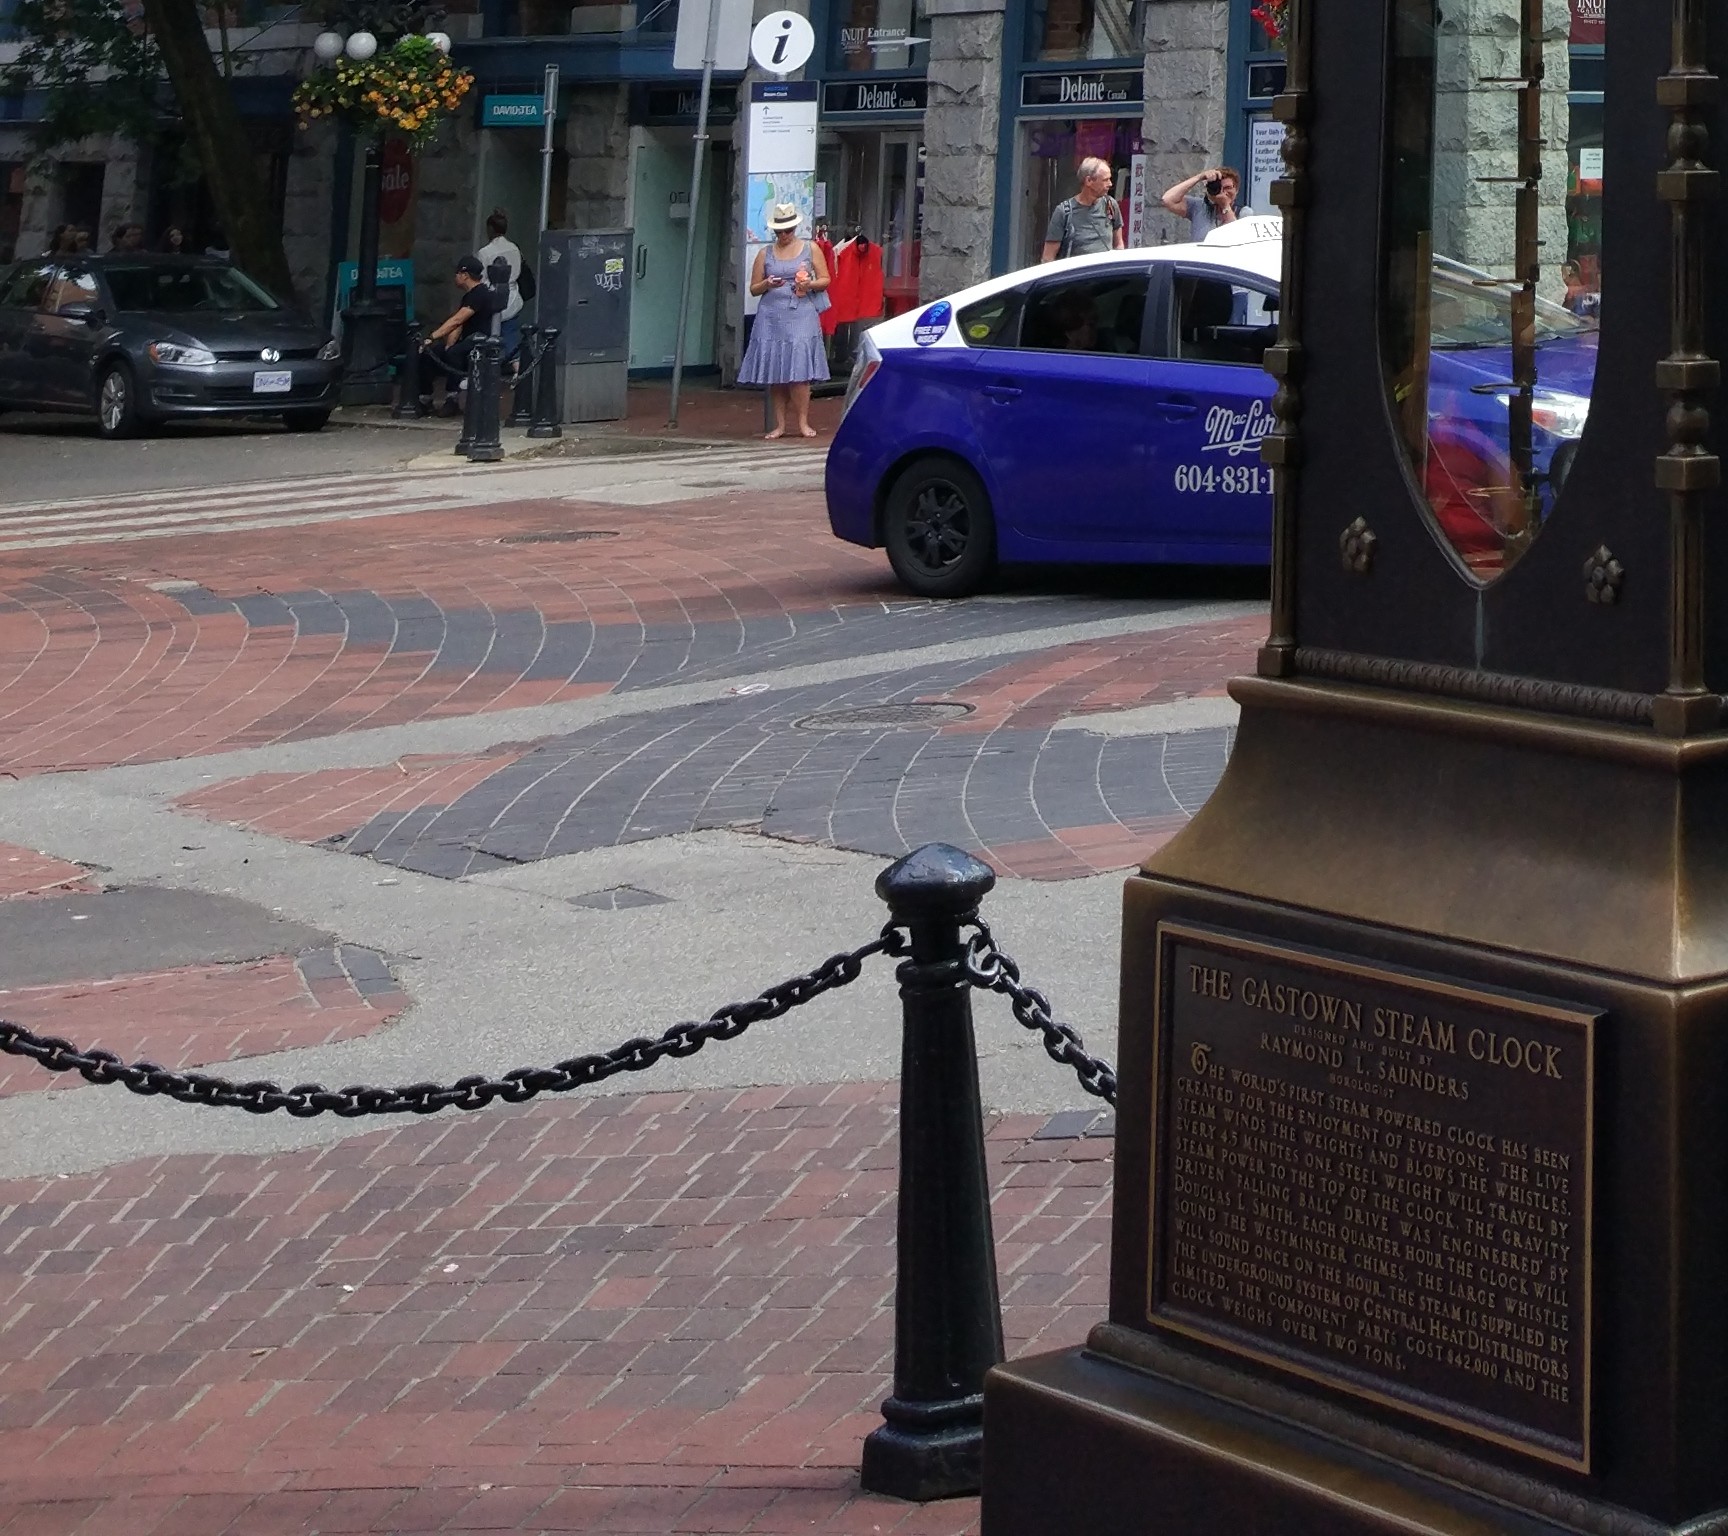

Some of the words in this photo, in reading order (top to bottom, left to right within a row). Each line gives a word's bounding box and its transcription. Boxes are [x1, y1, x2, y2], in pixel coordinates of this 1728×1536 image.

[867, 27, 906, 37] Entrance
[857, 83, 897, 109] Delané
[1060, 74, 1104, 102] Delané
[1188, 963, 1231, 1002] THE
[1241, 975, 1361, 1032] GASTOWN
[1373, 1005, 1456, 1056] STEAM
[1467, 1026, 1562, 1080] CLOCK
[1293, 1024, 1344, 1046] DESIGNED
[1351, 1037, 1373, 1053] AND
[1381, 1044, 1411, 1062] BUILT
[1419, 1052, 1432, 1066] BY
[1260, 1032, 1342, 1070] RAYMOND
[1356, 1054, 1370, 1076] L.
[1378, 1059, 1469, 1100] SAUNDERS
[1177, 1076, 1232, 1106] CREATED
[1239, 1092, 1265, 1114] FOR
[1269, 1100, 1294, 1122] THE
[1298, 1107, 1378, 1144] ENJOYMENT
[1385, 1130, 1403, 1150] OF
[1408, 1136, 1490, 1173] EVERYONE.
[1500, 1159, 1528, 1183] THE
[1536, 1169, 1569, 1194] LIVE
[1230, 1067, 1286, 1098] WORLD'S
[1288, 1084, 1324, 1109] FIRST
[1328, 1094, 1370, 1120] STEAM
[1375, 1106, 1442, 1139] POWERED
[1447, 1124, 1495, 1152] CLOCK
[1501, 1137, 1527, 1160] HAS
[1533, 1145, 1569, 1171] BEEN
[1176, 1096, 1215, 1121] STEAM
[1223, 1108, 1265, 1134] WINDS
[1272, 1121, 1296, 1143] THE
[1303, 1129, 1363, 1161] WEIGHTS
[1369, 1147, 1398, 1170] AND
[1406, 1156, 1453, 1185] BLOWS
[1460, 1171, 1487, 1194] THE
[1494, 1180, 1571, 1217] WHISTLES.
